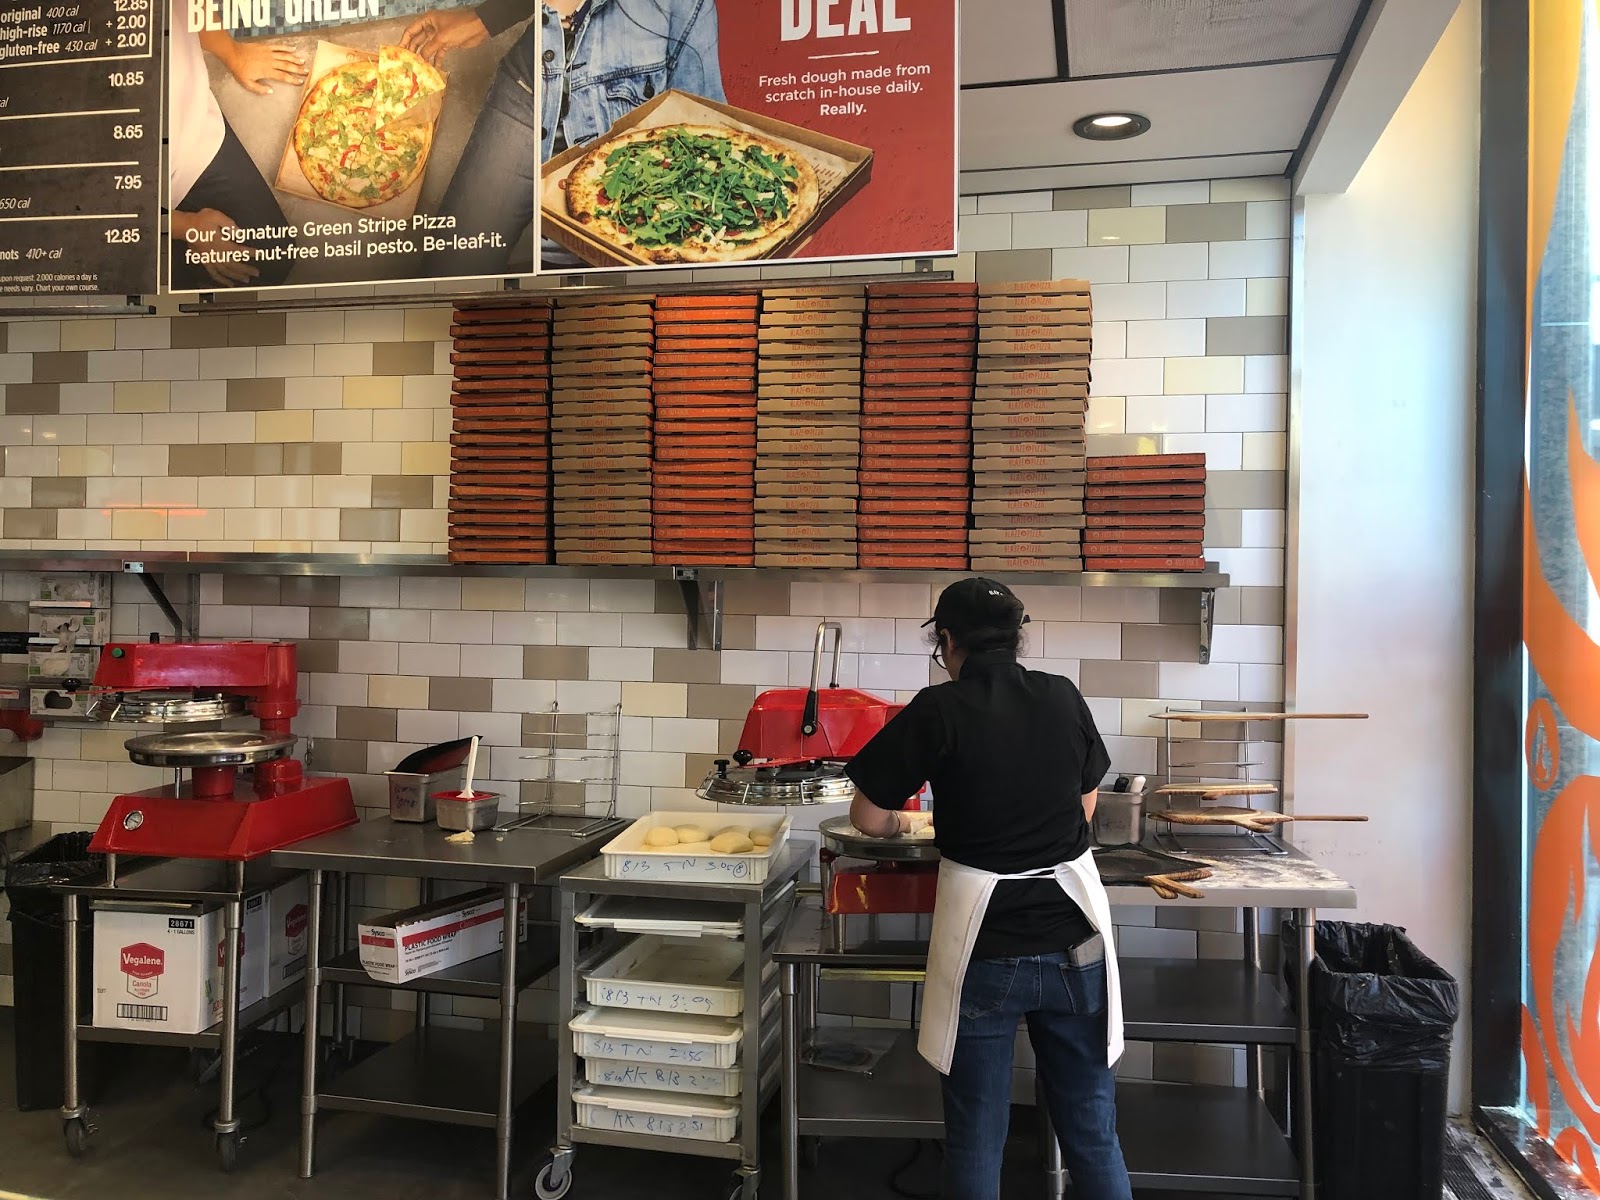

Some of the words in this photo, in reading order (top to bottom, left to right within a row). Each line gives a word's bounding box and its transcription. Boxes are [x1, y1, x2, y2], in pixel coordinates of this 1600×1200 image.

[1, 6, 41, 23] original
[46, 8, 64, 19] 400
[66, 5, 79, 17] cal
[114, 0, 148, 12] 12.85
[0, 24, 48, 42] high-rise
[52, 22, 72, 34] 1170
[73, 19, 86, 32] cal
[117, 15, 146, 30] 2.00
[117, 32, 146, 48] 2.00
[0, 41, 60, 60] gluten-free
[65, 40, 83, 52] 430
[84, 38, 98, 51] cal
[108, 71, 144, 87] 10.85
[759, 73, 796, 87] Fresh
[801, 69, 846, 84] dough
[851, 66, 891, 80] made
[896, 63, 931, 77] from
[765, 88, 815, 103] scratch
[820, 83, 881, 99] in-house
[886, 79, 923, 94] daily.
[820, 102, 867, 116] Really.
[113, 124, 143, 139] 8.65
[114, 175, 142, 190] 7.95
[18, 197, 31, 208] cal
[105, 228, 140, 244] 12.85
[185, 228, 216, 243] Our
[221, 224, 298, 244] Signature
[303, 222, 352, 237] Green
[358, 217, 407, 235] Stripe
[412, 214, 456, 230] Pizza
[49, 248, 63, 259] cal
[185, 249, 250, 264] features
[255, 244, 319, 261] nut-free
[324, 240, 361, 258] basil
[366, 238, 417, 258] pesto.
[424, 232, 506, 252] Be-leaf-it.
[81, 273, 92, 281] day
[371, 929, 385, 937] Sysco
[405, 940, 426, 951] PLASTIC
[427, 936, 441, 945] FOOD
[443, 931, 457, 940] WRAP
[614, 1111, 634, 1128] KK
